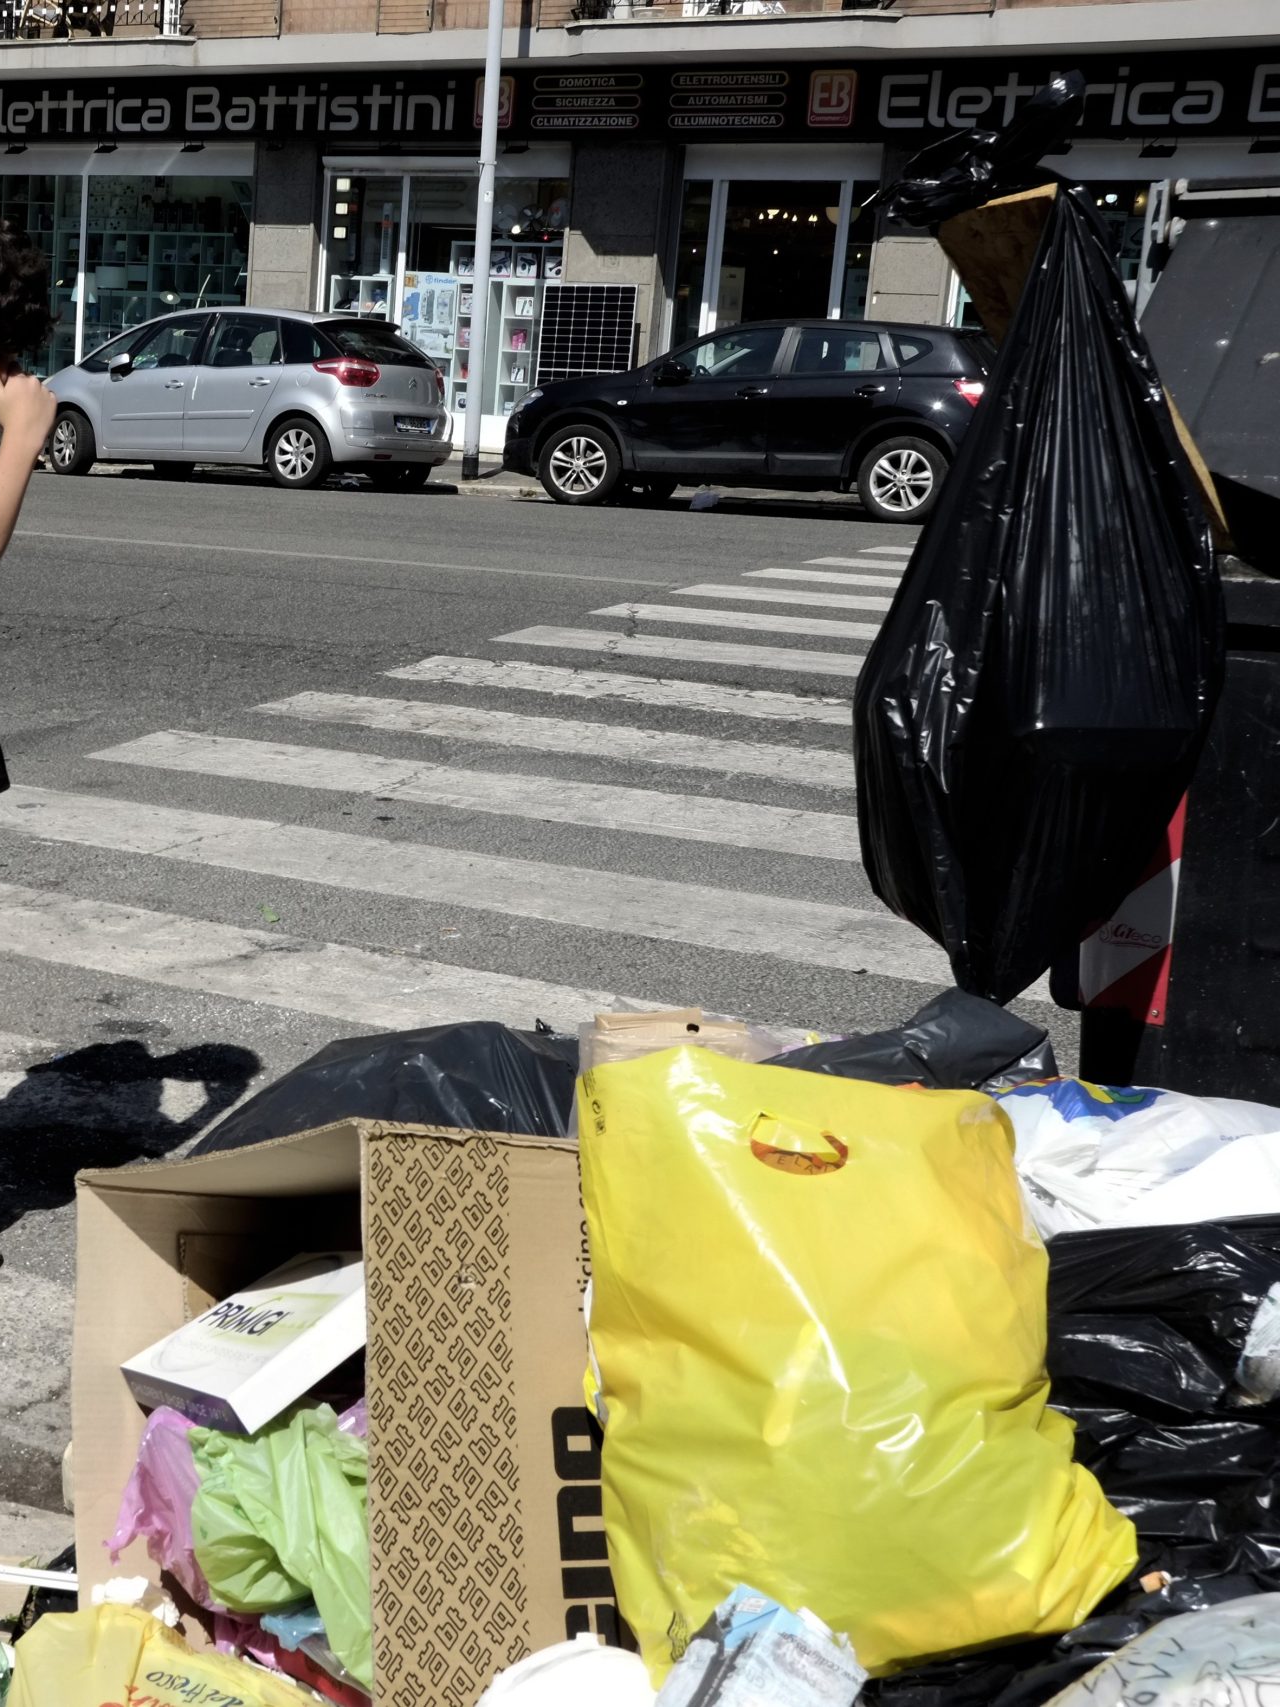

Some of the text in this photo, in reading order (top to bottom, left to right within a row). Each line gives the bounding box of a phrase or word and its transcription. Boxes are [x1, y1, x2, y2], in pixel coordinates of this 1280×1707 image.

[559, 77, 616, 87] DOMOTICA
[679, 74, 780, 85] ELETTROUTENSILI
[555, 97, 616, 107] SICUREZZA
[687, 95, 768, 105] AUTOMATISMI
[186, 80, 455, 133] Battistini
[536, 117, 633, 126] CLIMATIZZAZIONE
[674, 115, 777, 126] ILLUMINOTECNICA
[198, 1301, 288, 1337] PRIMIGI
